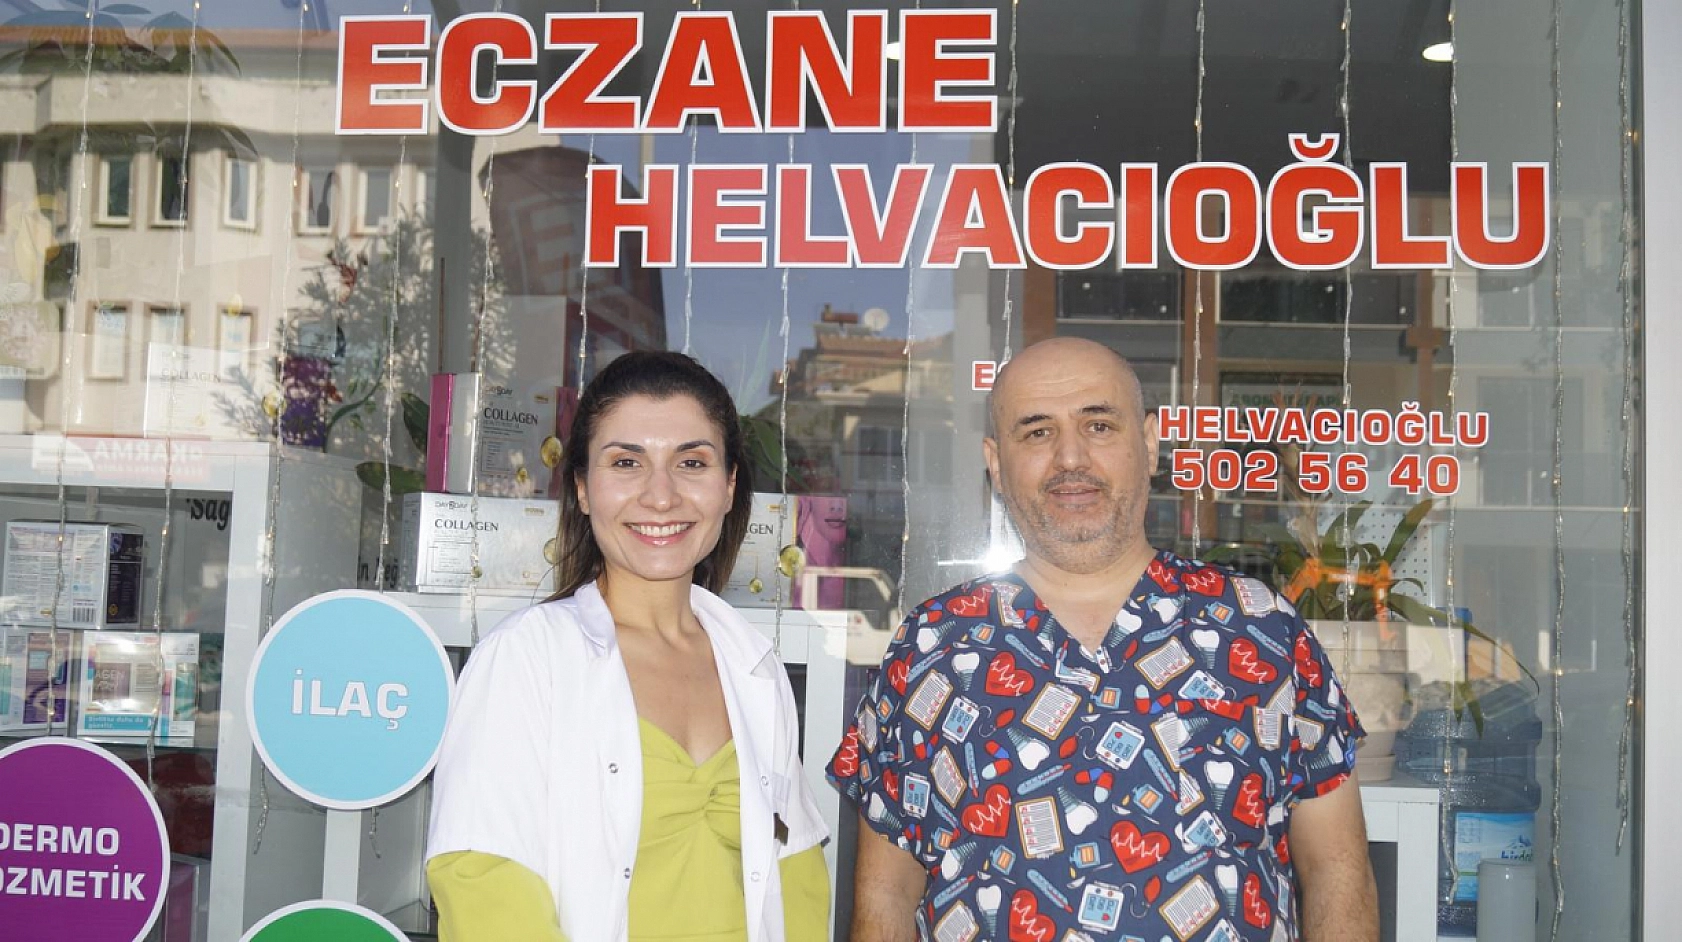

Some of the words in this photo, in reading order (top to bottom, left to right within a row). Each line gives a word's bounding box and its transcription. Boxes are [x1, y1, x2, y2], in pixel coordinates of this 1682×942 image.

[334, 7, 999, 135] ECZANE
[584, 132, 1552, 271] HELVACIOĞLU
[484, 407, 538, 425] COLLAGEN
[1158, 401, 1489, 446] HELVACIOĞLU
[1171, 449, 1279, 492] 502
[1298, 451, 1370, 493] 56
[1388, 454, 1461, 495] 40
[434, 518, 499, 532] COLLAGEN
[292, 670, 410, 731] İLAÇ
[0, 865, 147, 902] ZMETİK
